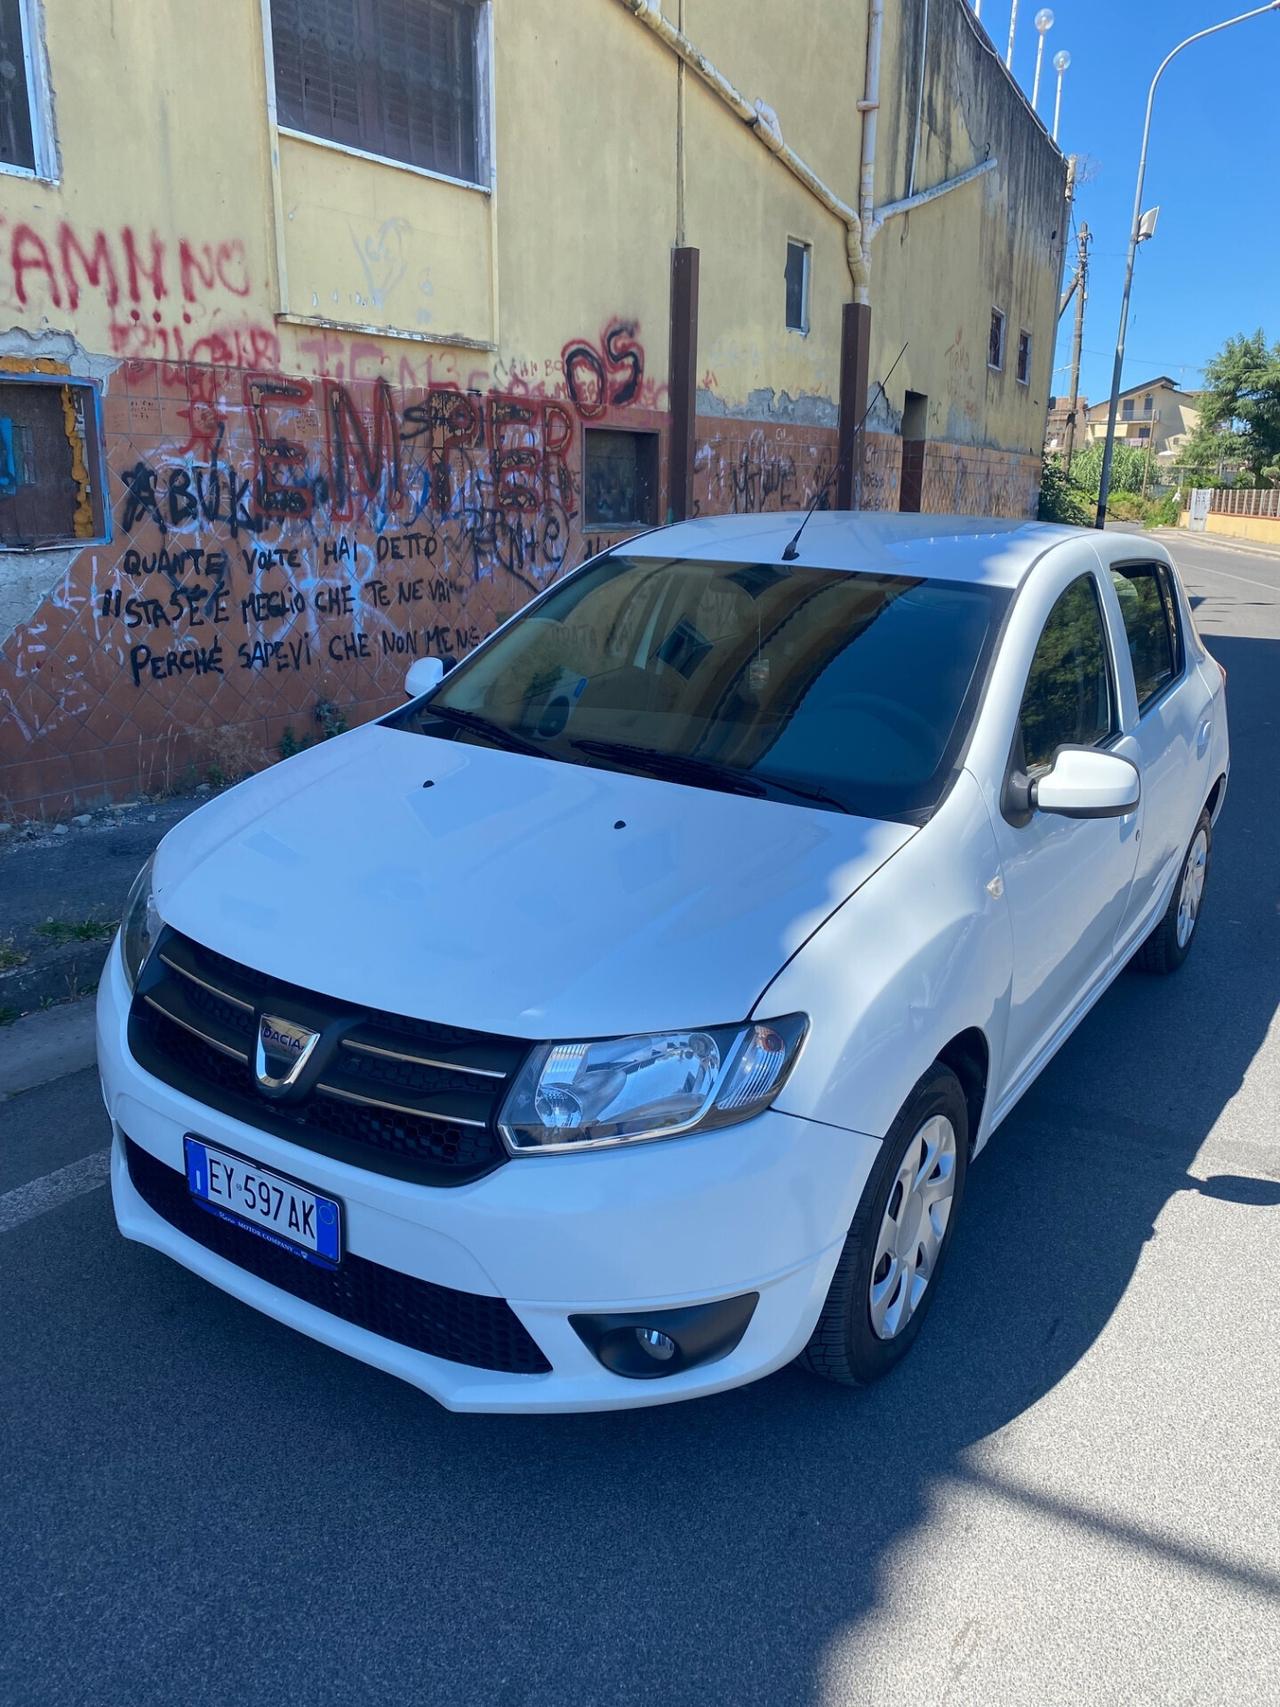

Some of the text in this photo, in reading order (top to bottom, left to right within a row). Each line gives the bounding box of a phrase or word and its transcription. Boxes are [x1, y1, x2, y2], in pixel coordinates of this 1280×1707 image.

[123, 532, 437, 576] QUANTE VOLTE HAI DETTO
[241, 586, 306, 624] MEGLIO
[315, 585, 355, 616] CHE
[364, 580, 391, 608] TE
[398, 578, 423, 605] NE
[329, 632, 370, 661] CHE
[382, 628, 417, 655] NON
[262, 1027, 305, 1051] DACIA
[208, 1158, 235, 1200] EY
